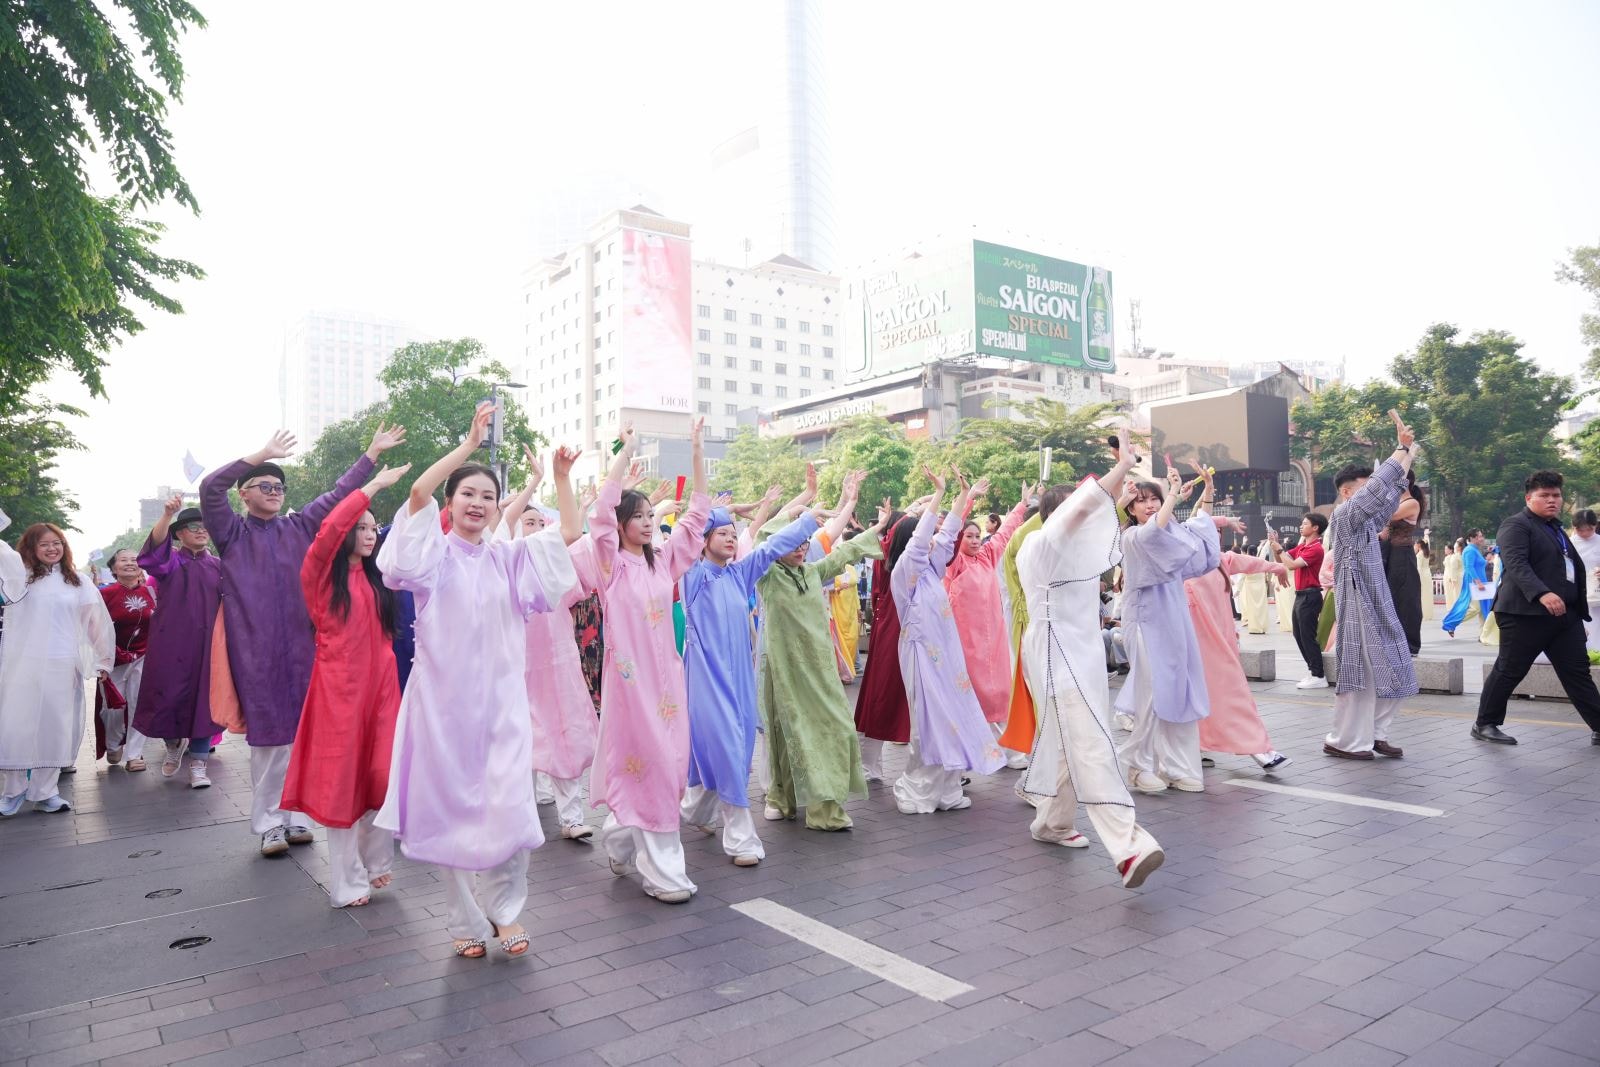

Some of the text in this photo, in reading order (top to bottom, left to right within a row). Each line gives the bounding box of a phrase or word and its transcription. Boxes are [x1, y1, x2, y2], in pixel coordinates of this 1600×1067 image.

[1003, 257, 1038, 273] スペシャル
[896, 280, 920, 302] BIA
[1027, 274, 1051, 293] BIA
[1050, 279, 1080, 297] SPEZIAL
[880, 320, 941, 351] SPECIAL
[1008, 314, 1073, 341] SPECIAL
[660, 395, 688, 408] DIOR
[792, 399, 873, 430] SAIGON GARDEN
